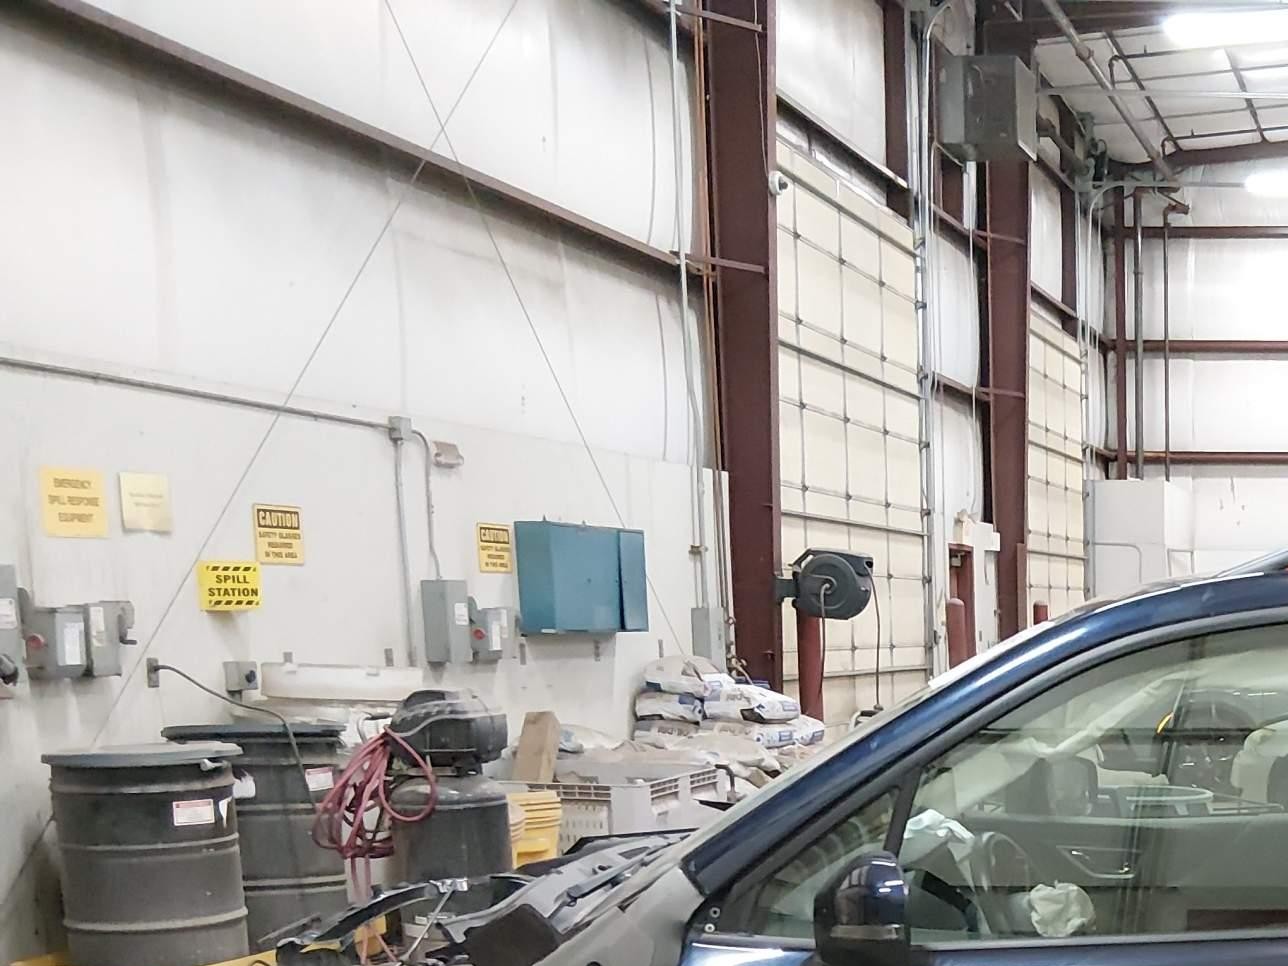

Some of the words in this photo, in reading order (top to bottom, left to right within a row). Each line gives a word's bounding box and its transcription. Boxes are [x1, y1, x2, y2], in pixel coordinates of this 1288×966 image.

[259, 511, 299, 528] CAUTION
[215, 574, 250, 584] SPILL
[208, 587, 258, 597] STATION
